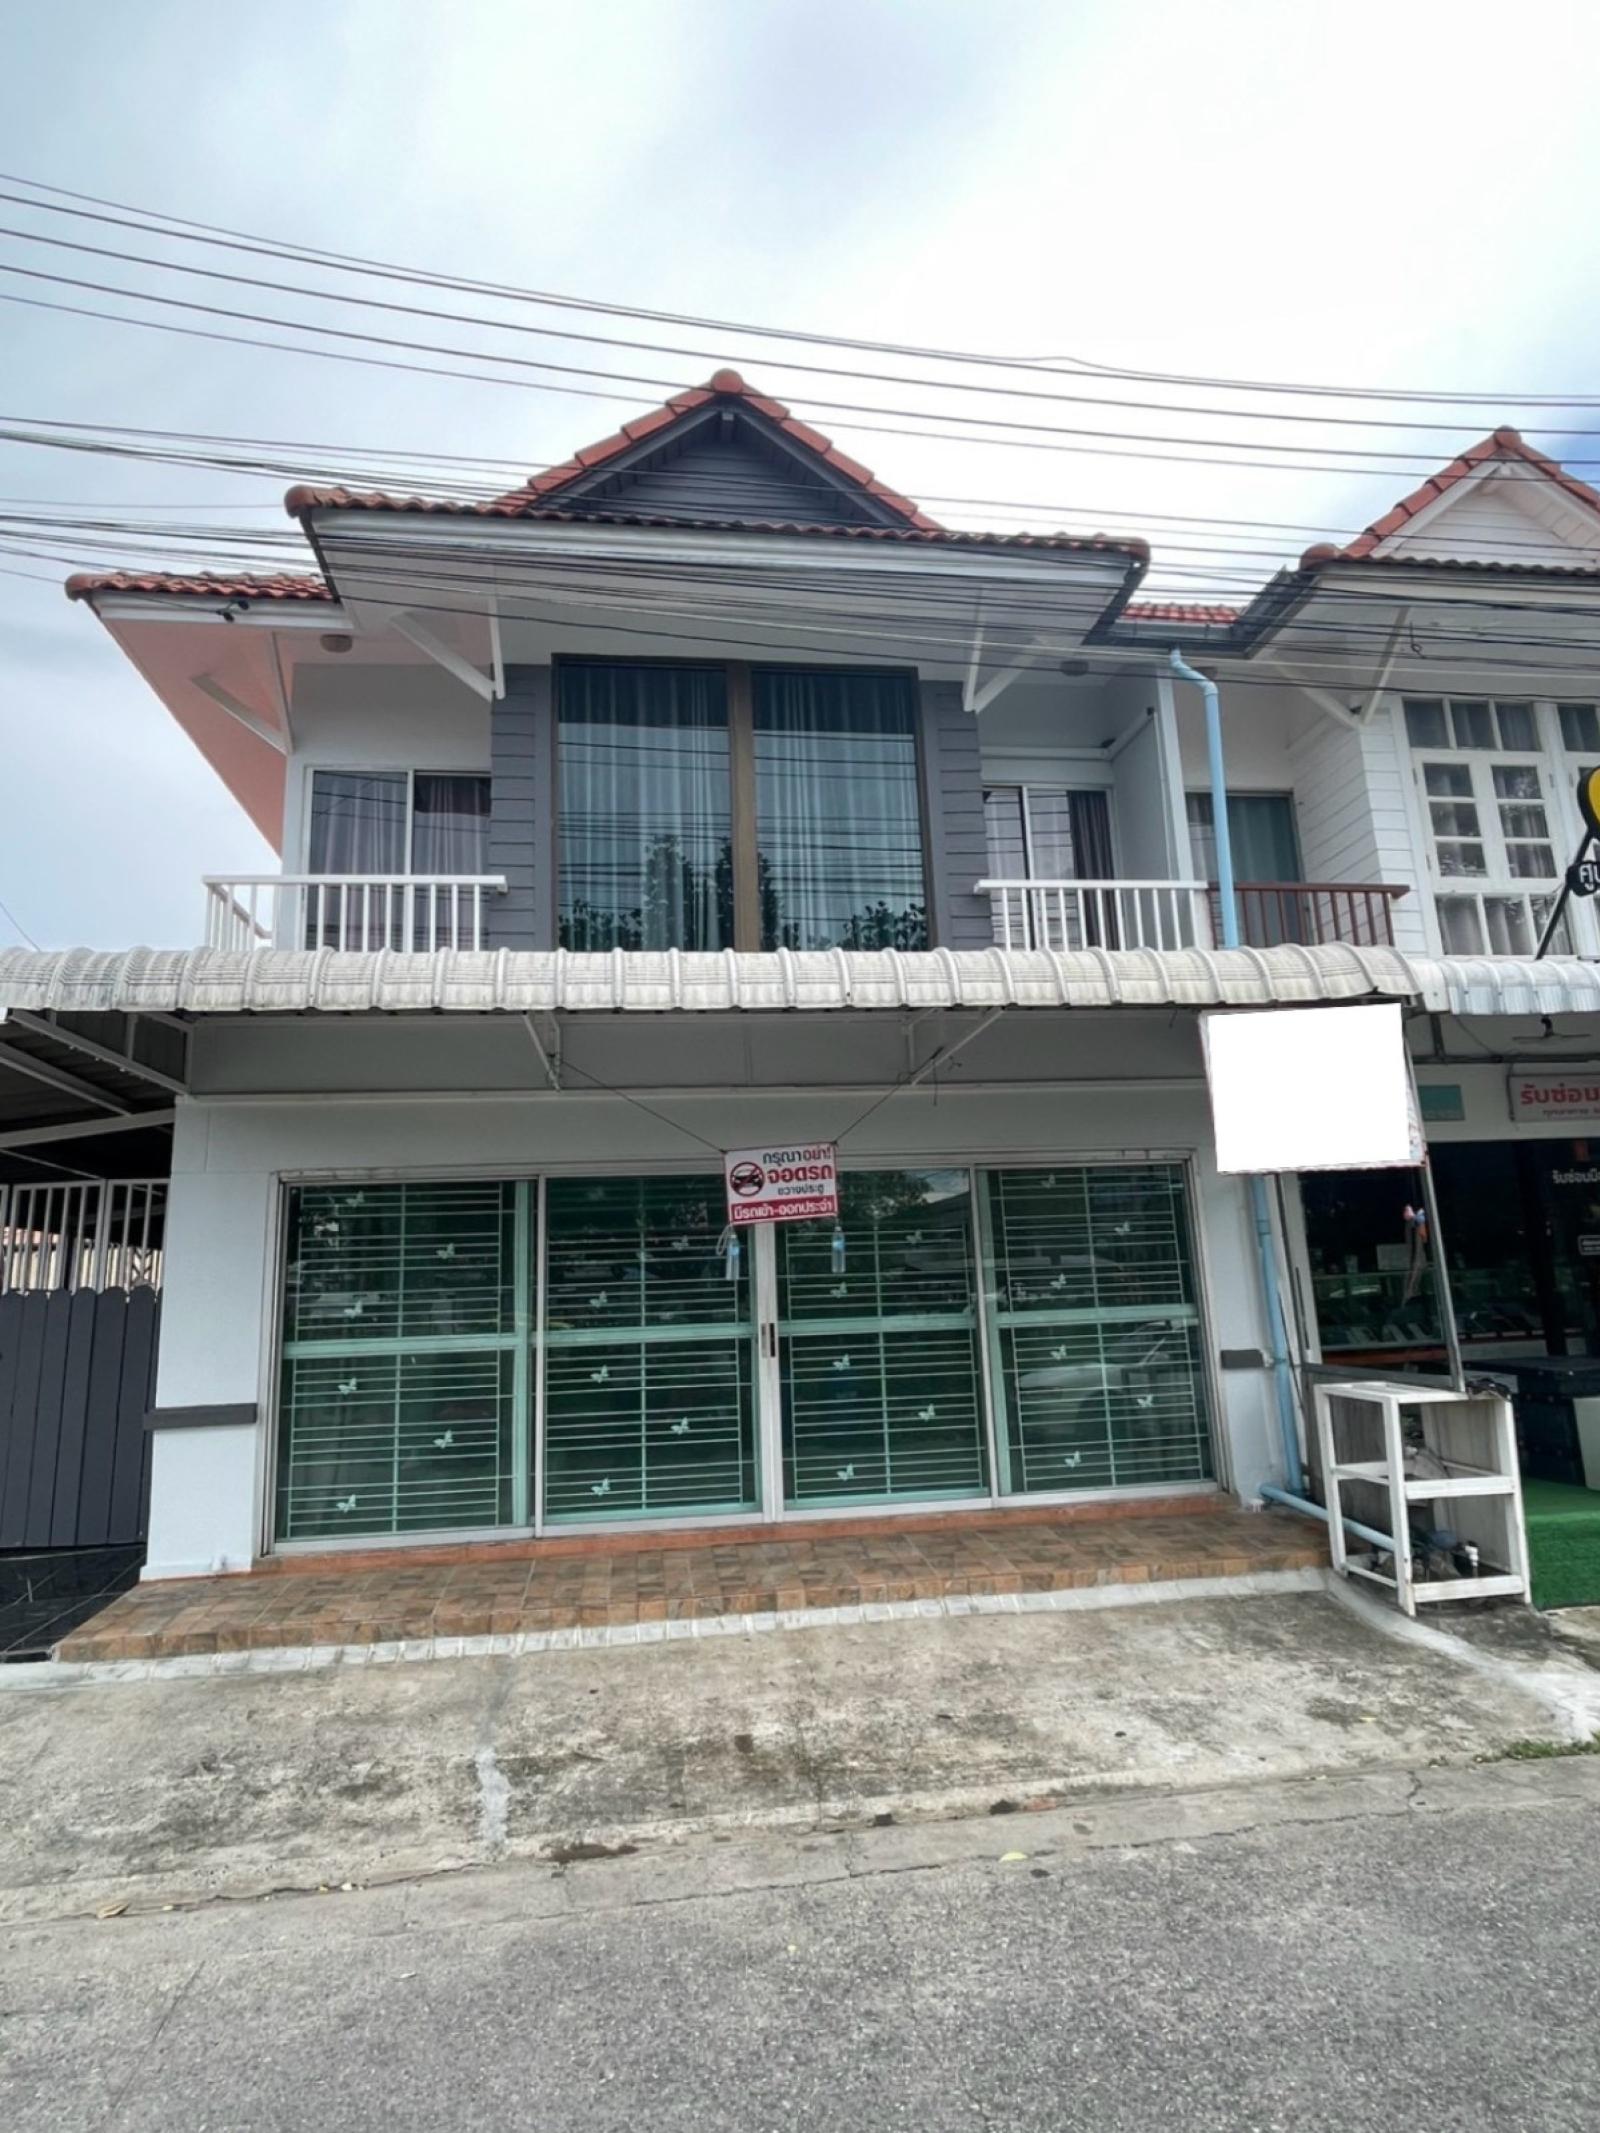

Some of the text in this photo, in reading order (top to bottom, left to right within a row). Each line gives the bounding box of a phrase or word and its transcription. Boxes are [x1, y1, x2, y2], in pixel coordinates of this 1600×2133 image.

[767, 1165, 833, 1184] จอดรถ
[777, 1183, 825, 1196] ขวางประตู
